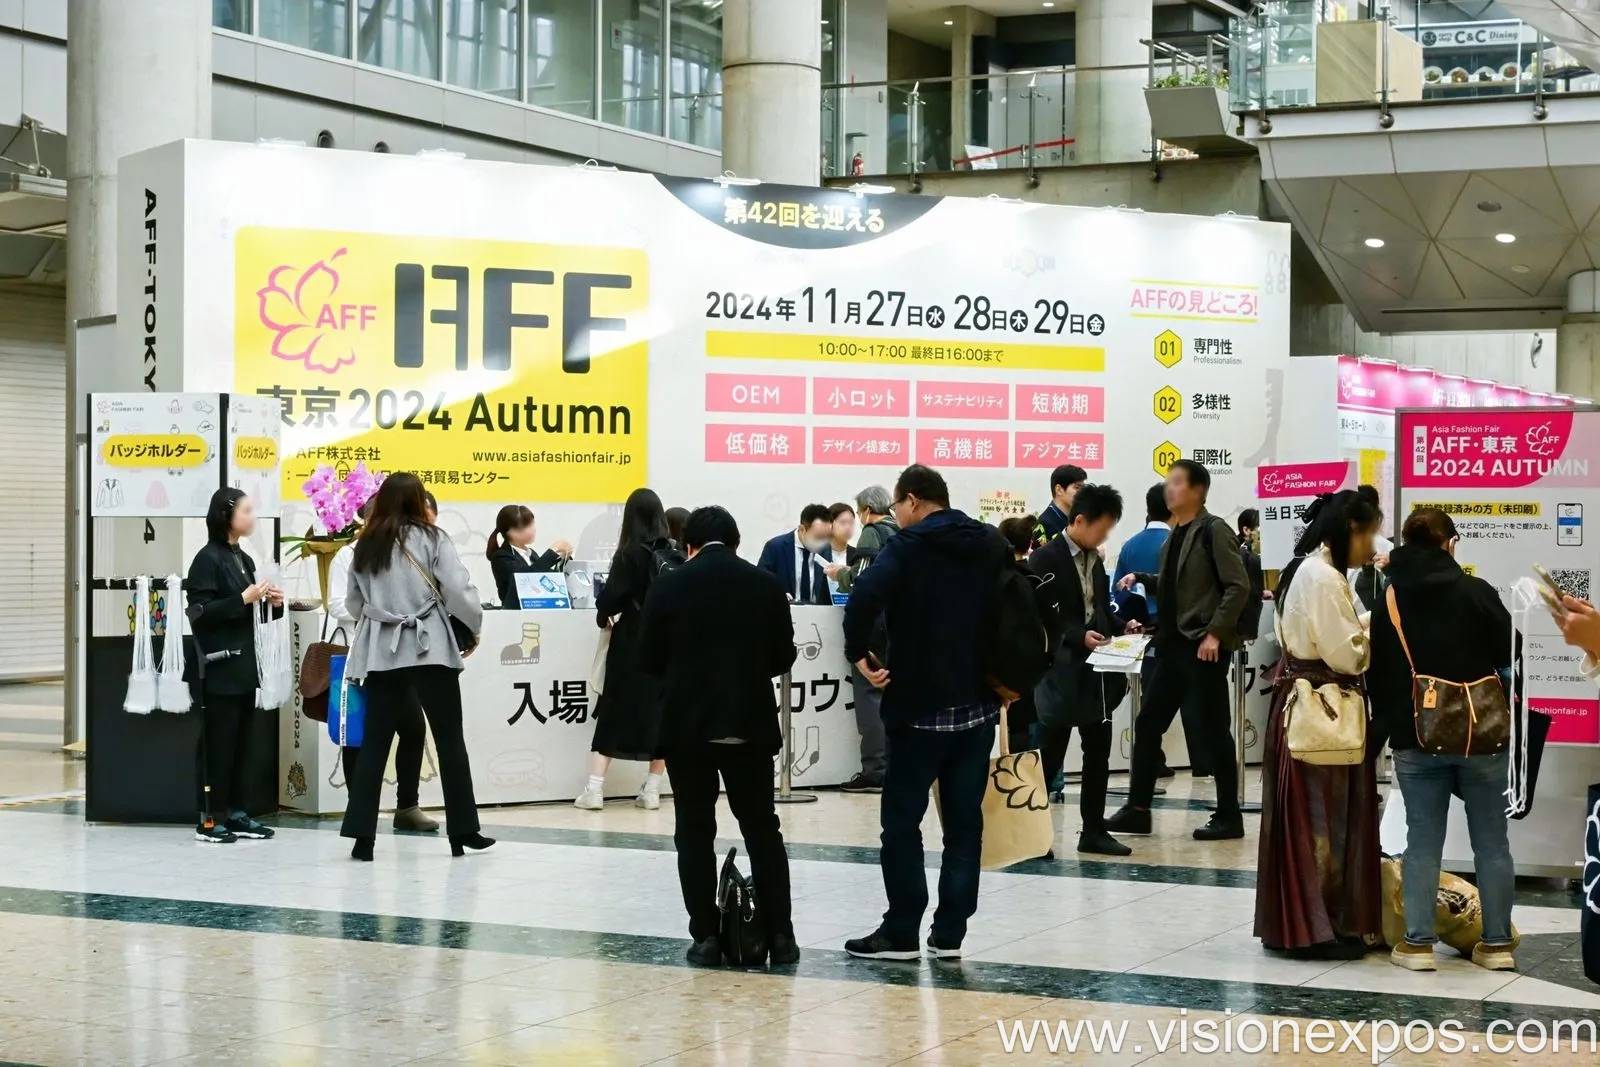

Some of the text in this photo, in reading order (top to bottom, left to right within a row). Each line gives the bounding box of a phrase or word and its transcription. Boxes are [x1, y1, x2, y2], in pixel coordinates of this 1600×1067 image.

[1455, 30, 1487, 44] C&C
[724, 198, 885, 233] 第42回を迎える
[144, 188, 157, 392] AFF・TOKY
[315, 303, 377, 331] AFF
[394, 263, 632, 374] AFF
[1160, 340, 1175, 356] 01
[1193, 337, 1233, 355] 専門性
[1193, 356, 1243, 365] Professionalism
[732, 384, 780, 405] OEM
[828, 386, 896, 410] 小ロット
[922, 393, 1004, 408] サステナビリティ
[1192, 393, 1231, 410] 多様性
[348, 388, 452, 431] 2024
[465, 392, 631, 435] Autumn
[1032, 392, 1089, 415] 短納期
[1159, 396, 1176, 412] 02
[1193, 412, 1221, 421] Diversity
[1432, 425, 1500, 433] Asia Fashion Fair
[726, 432, 790, 456] 低価格
[822, 438, 901, 455] デザイン提案力
[1541, 435, 1560, 444] AFF
[110, 443, 201, 458] バッジホルダー
[472, 450, 631, 465] www.asiafashionfair.jp
[933, 437, 993, 461] 高機能
[1021, 442, 1100, 461] アジア生産
[1193, 449, 1232, 466] 国際化
[1159, 452, 1176, 468] 03
[1430, 459, 1589, 477] 2024 AUTUMN
[1285, 473, 1303, 481] ASIA
[1285, 480, 1337, 489] FASHION FAIR
[507, 680, 601, 726] 入場
